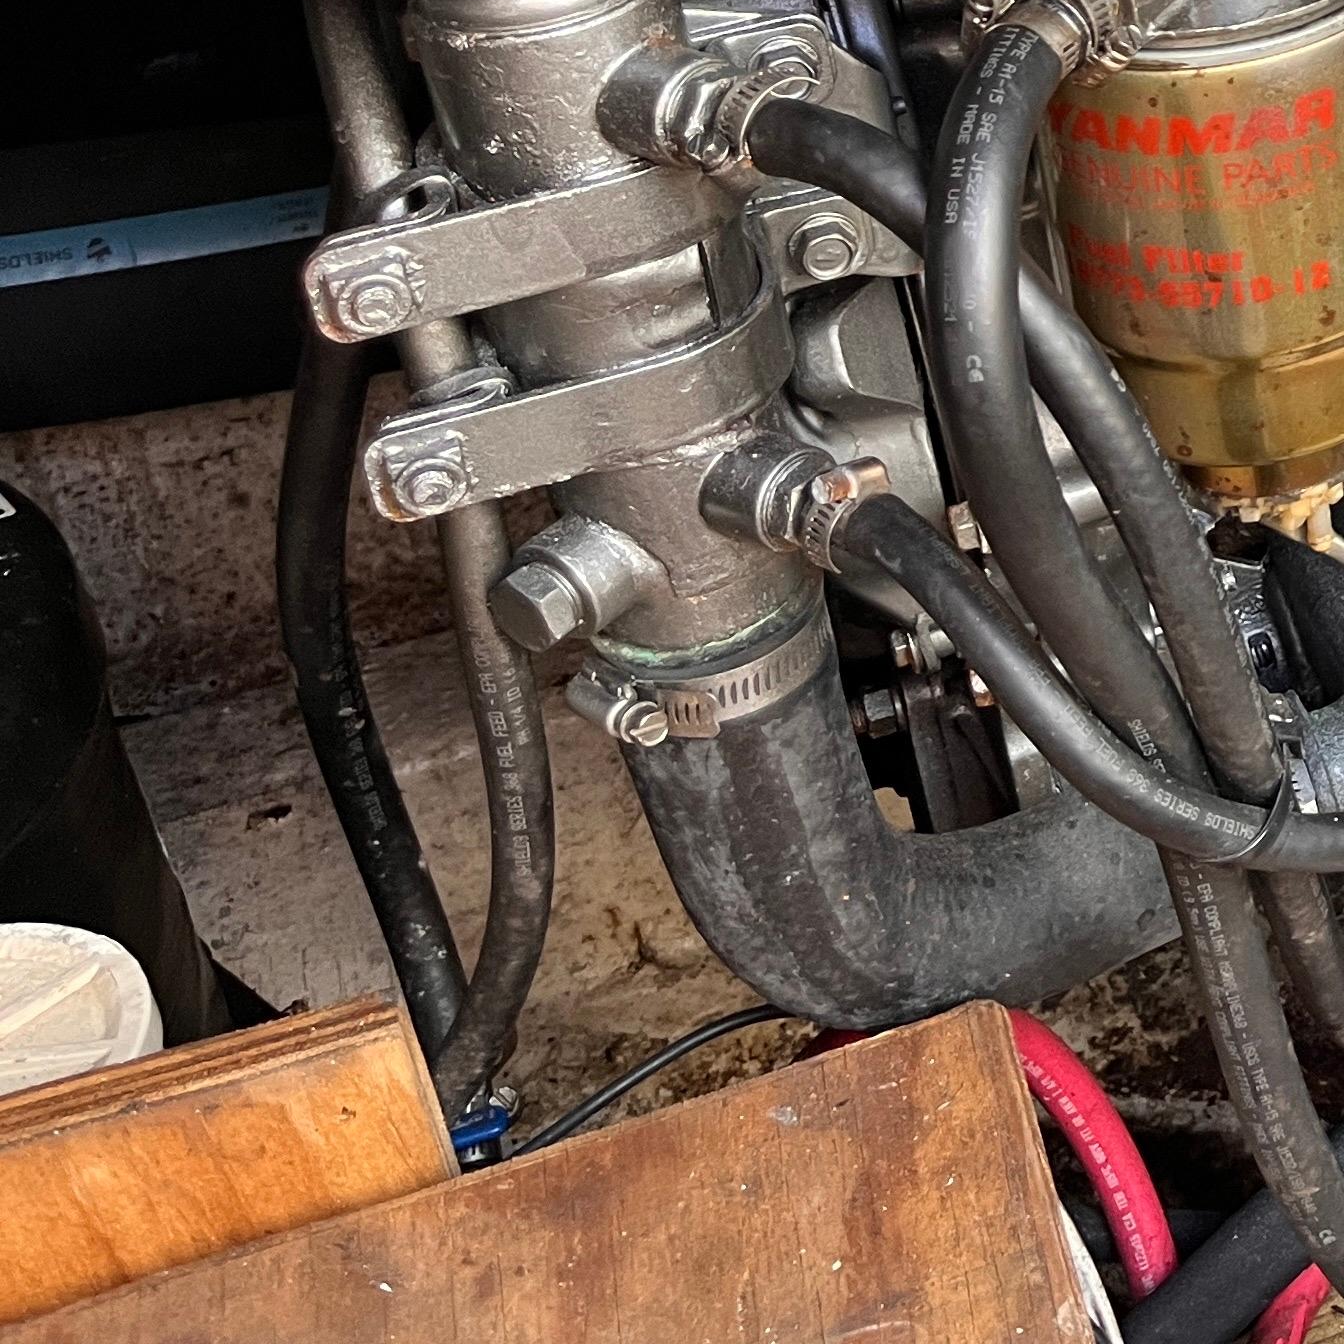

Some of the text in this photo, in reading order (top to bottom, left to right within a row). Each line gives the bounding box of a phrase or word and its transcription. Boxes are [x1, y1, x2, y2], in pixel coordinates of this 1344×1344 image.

[1009, 30, 1039, 61] TYPE
[956, 103, 980, 145] MADE
[975, 111, 998, 144] SAE
[1048, 87, 1338, 157] YANMAR
[950, 157, 967, 178] IN
[1222, 138, 1340, 190] PARTS
[944, 187, 961, 224] USA
[486, 708, 510, 738] FEED
[494, 740, 516, 769] FUEL
[1092, 736, 1128, 772] FUEL
[505, 794, 527, 831] SERIES
[1151, 786, 1202, 822] SERIES
[1202, 810, 1259, 842] SHIELDS
